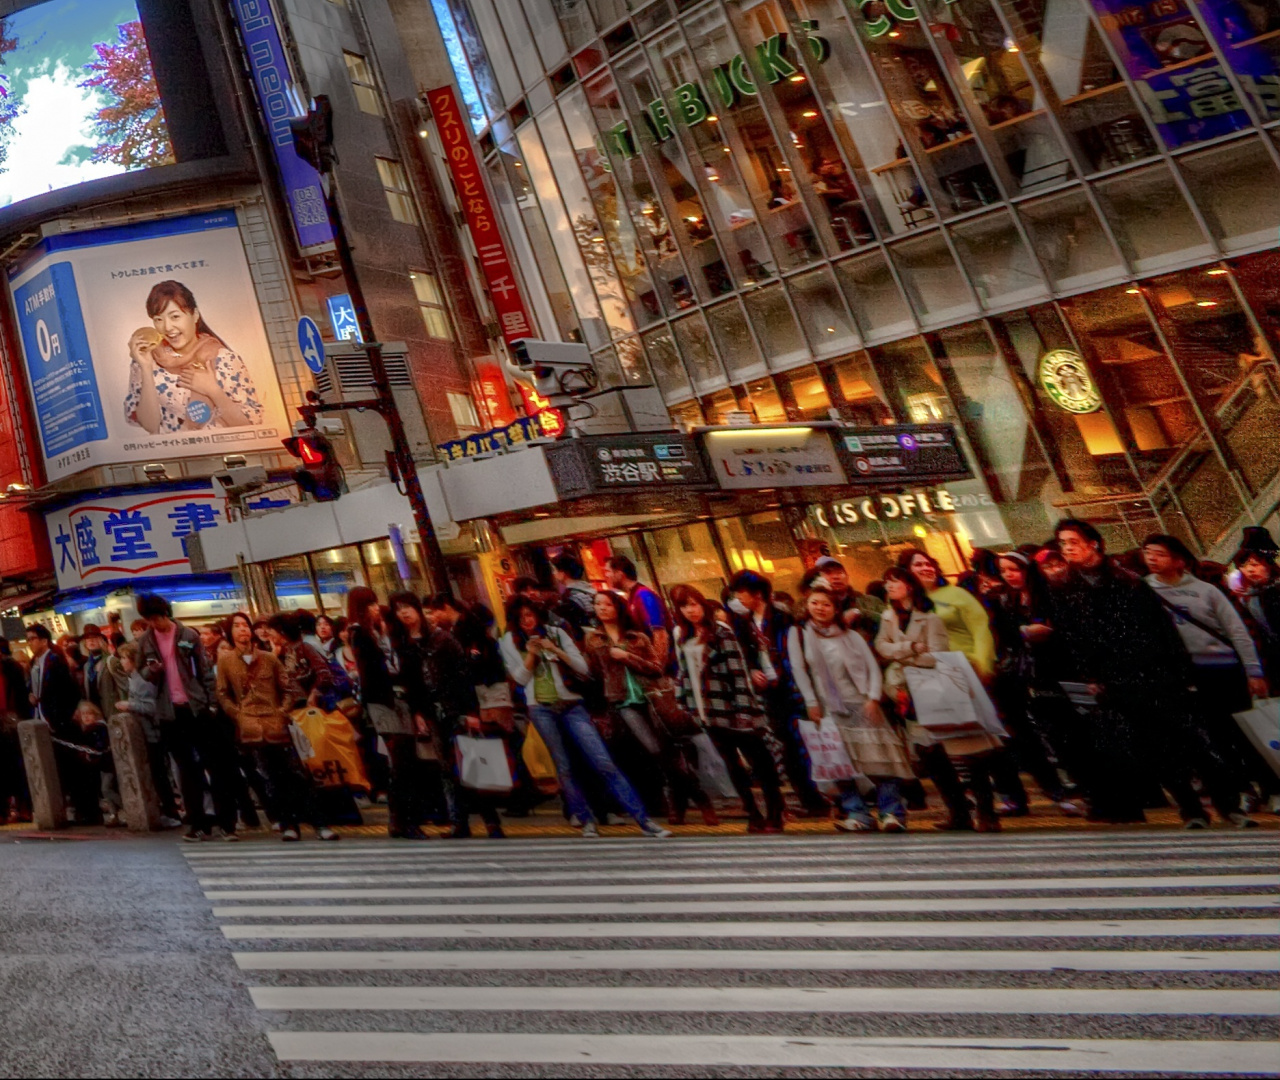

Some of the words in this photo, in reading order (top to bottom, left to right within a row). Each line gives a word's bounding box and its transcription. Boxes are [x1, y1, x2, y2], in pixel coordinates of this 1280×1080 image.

[251, 39, 294, 147] neon
[436, 95, 490, 232] クスリのことなら
[481, 243, 531, 335] 三千里
[110, 259, 209, 279] トクしたお金で食べてます。
[24, 284, 56, 316] ATM手数料
[36, 318, 61, 362] 0円
[123, 436, 209, 451] 0円ハッピーサイト公開中!!
[601, 462, 661, 482] 渋谷駅
